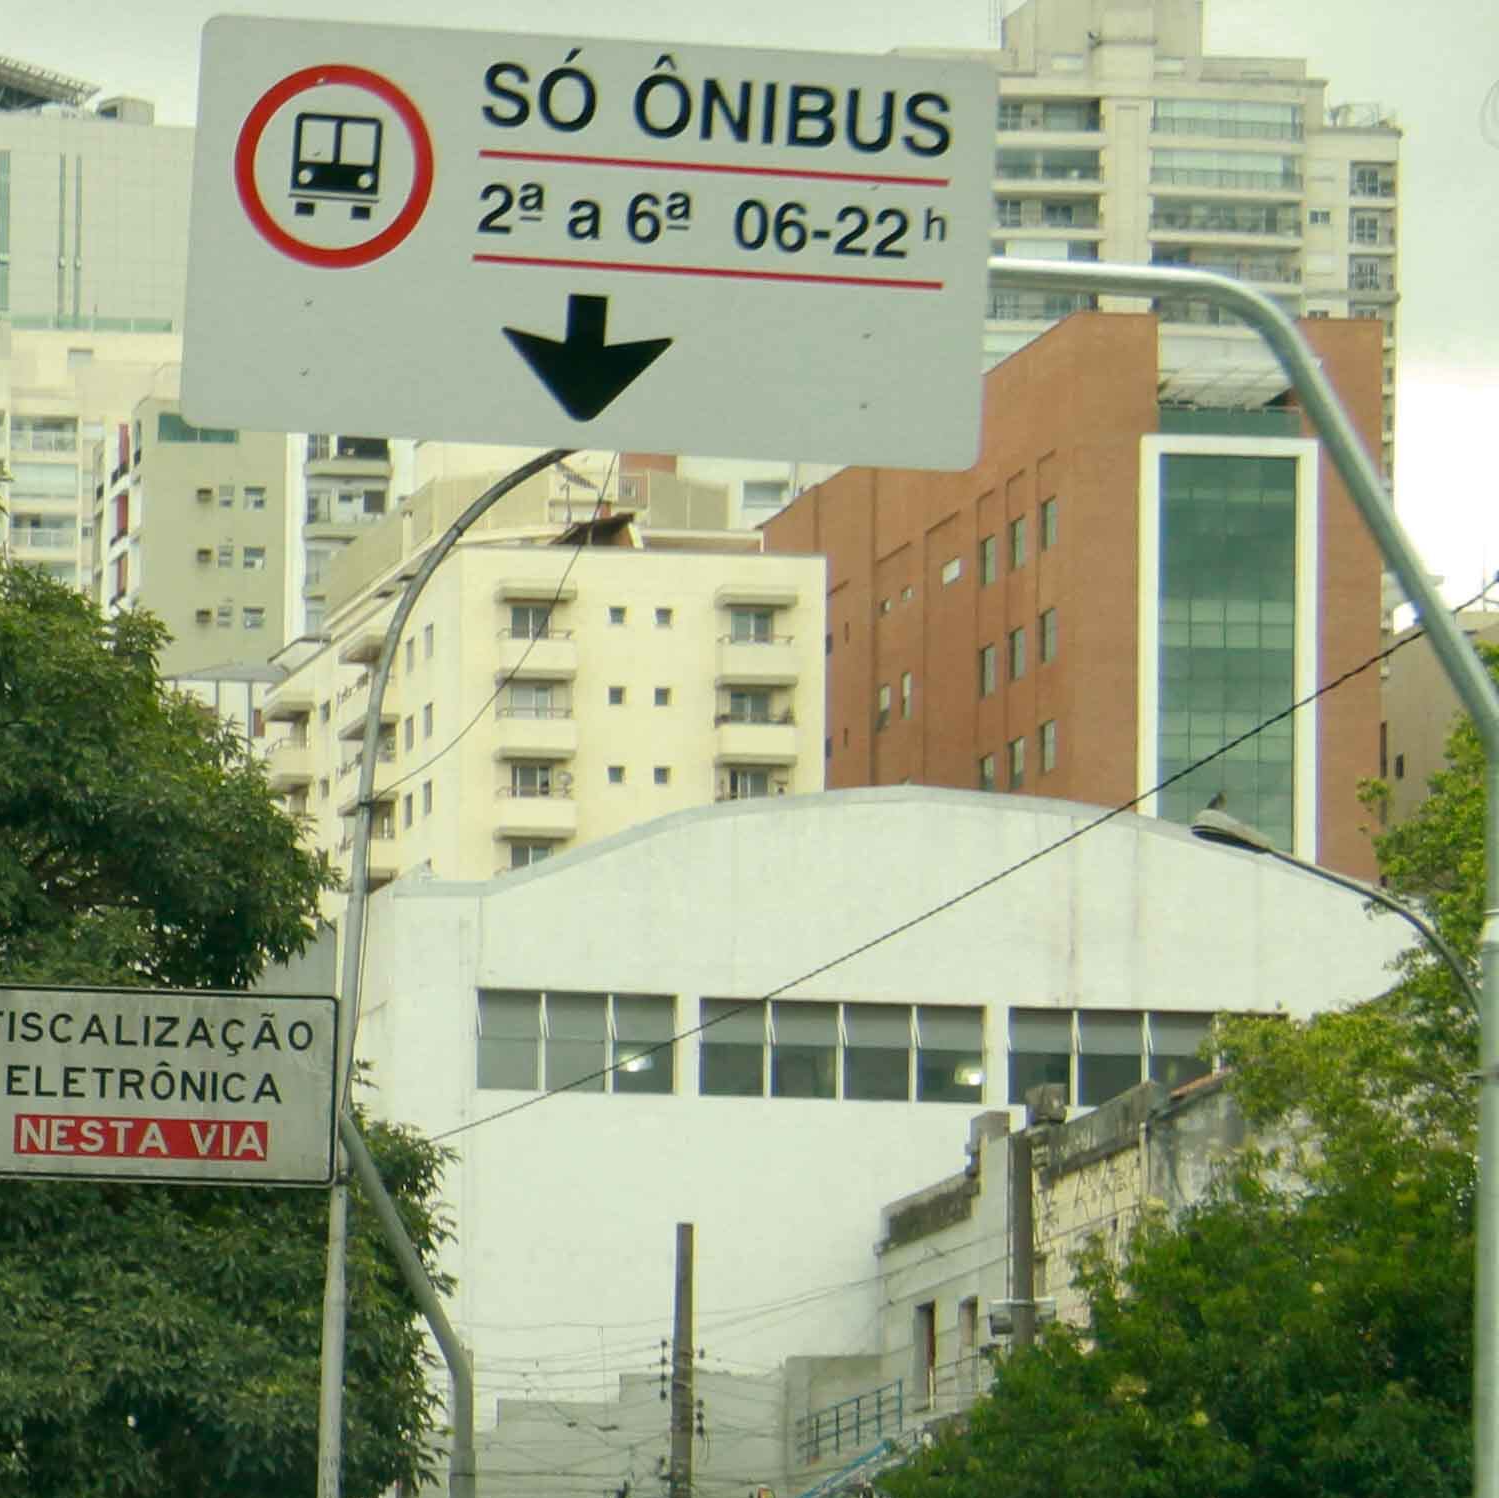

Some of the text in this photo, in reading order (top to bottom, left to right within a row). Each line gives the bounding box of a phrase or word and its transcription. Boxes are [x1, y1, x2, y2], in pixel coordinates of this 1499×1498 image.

[482, 48, 952, 157] SÓ ÔNIBUS
[567, 200, 602, 240] a
[5, 1060, 283, 1104] ELETRÔNICA
[18, 1115, 265, 1158] NESTA VIA
